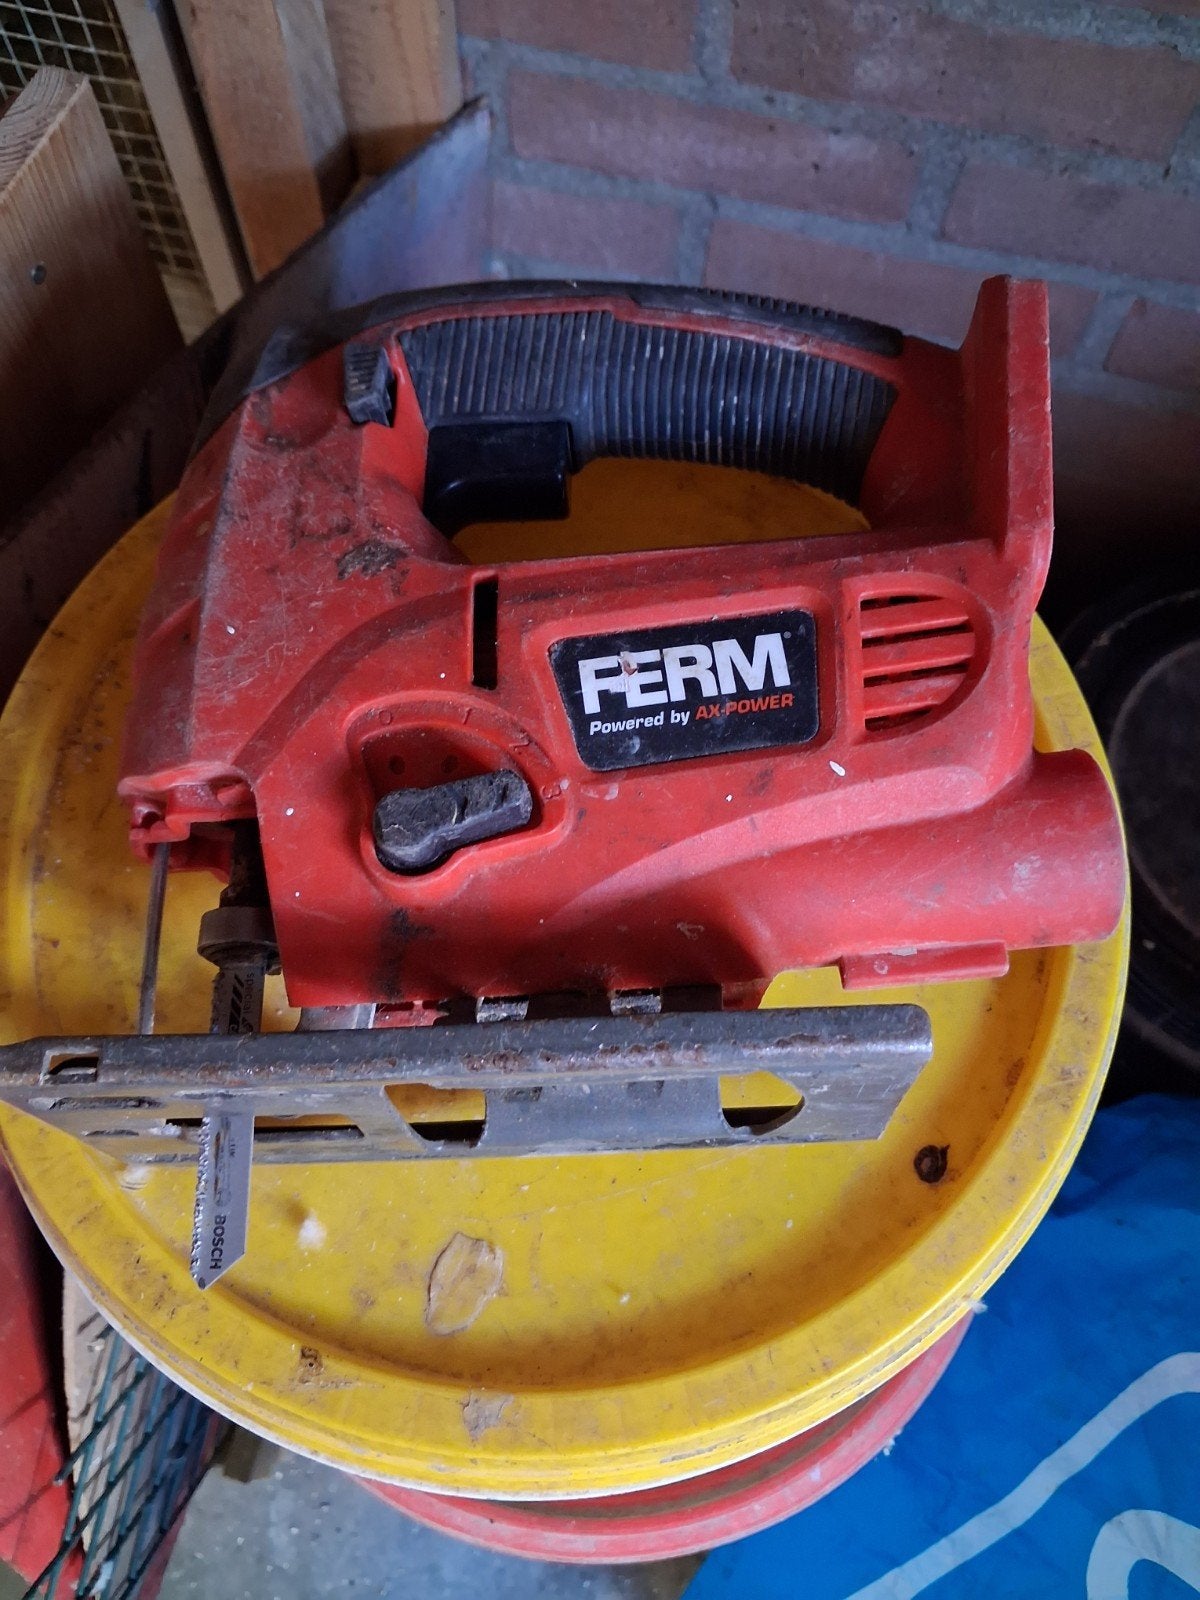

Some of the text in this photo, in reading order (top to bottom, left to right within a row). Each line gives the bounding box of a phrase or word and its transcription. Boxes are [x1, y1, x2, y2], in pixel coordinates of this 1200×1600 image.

[577, 632, 792, 715] FERM
[589, 693, 795, 736] Powered by AX-POWER
[209, 1214, 227, 1271] BOSCH
